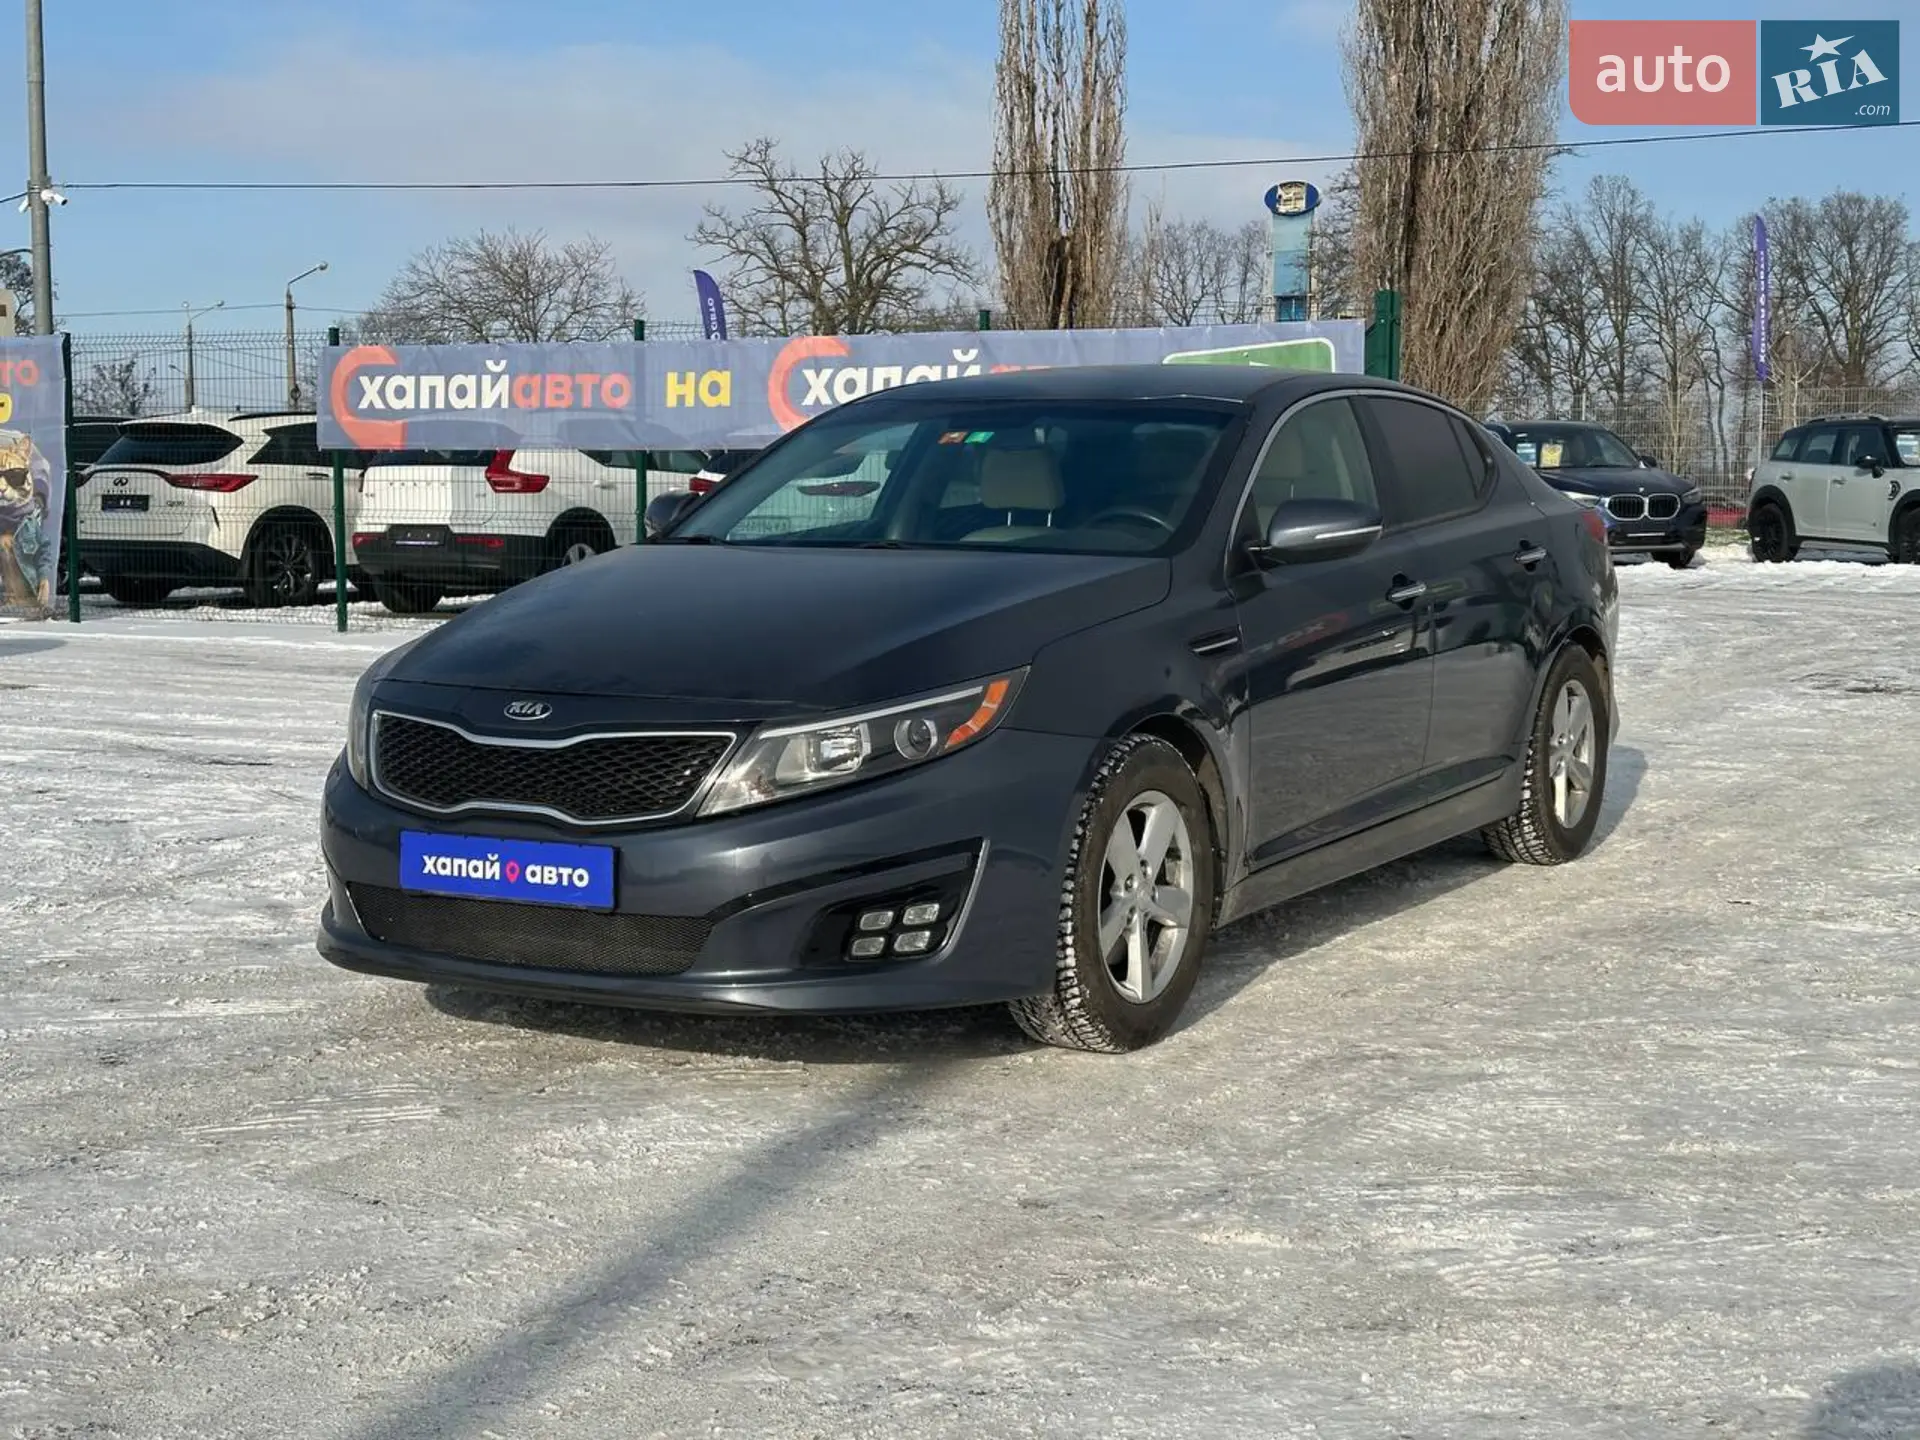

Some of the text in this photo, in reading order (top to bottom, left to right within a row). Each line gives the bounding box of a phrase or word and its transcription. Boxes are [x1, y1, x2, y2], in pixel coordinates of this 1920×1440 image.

[665, 369, 731, 408] на
[508, 700, 547, 716] KIA
[422, 853, 590, 888] хапай авто
